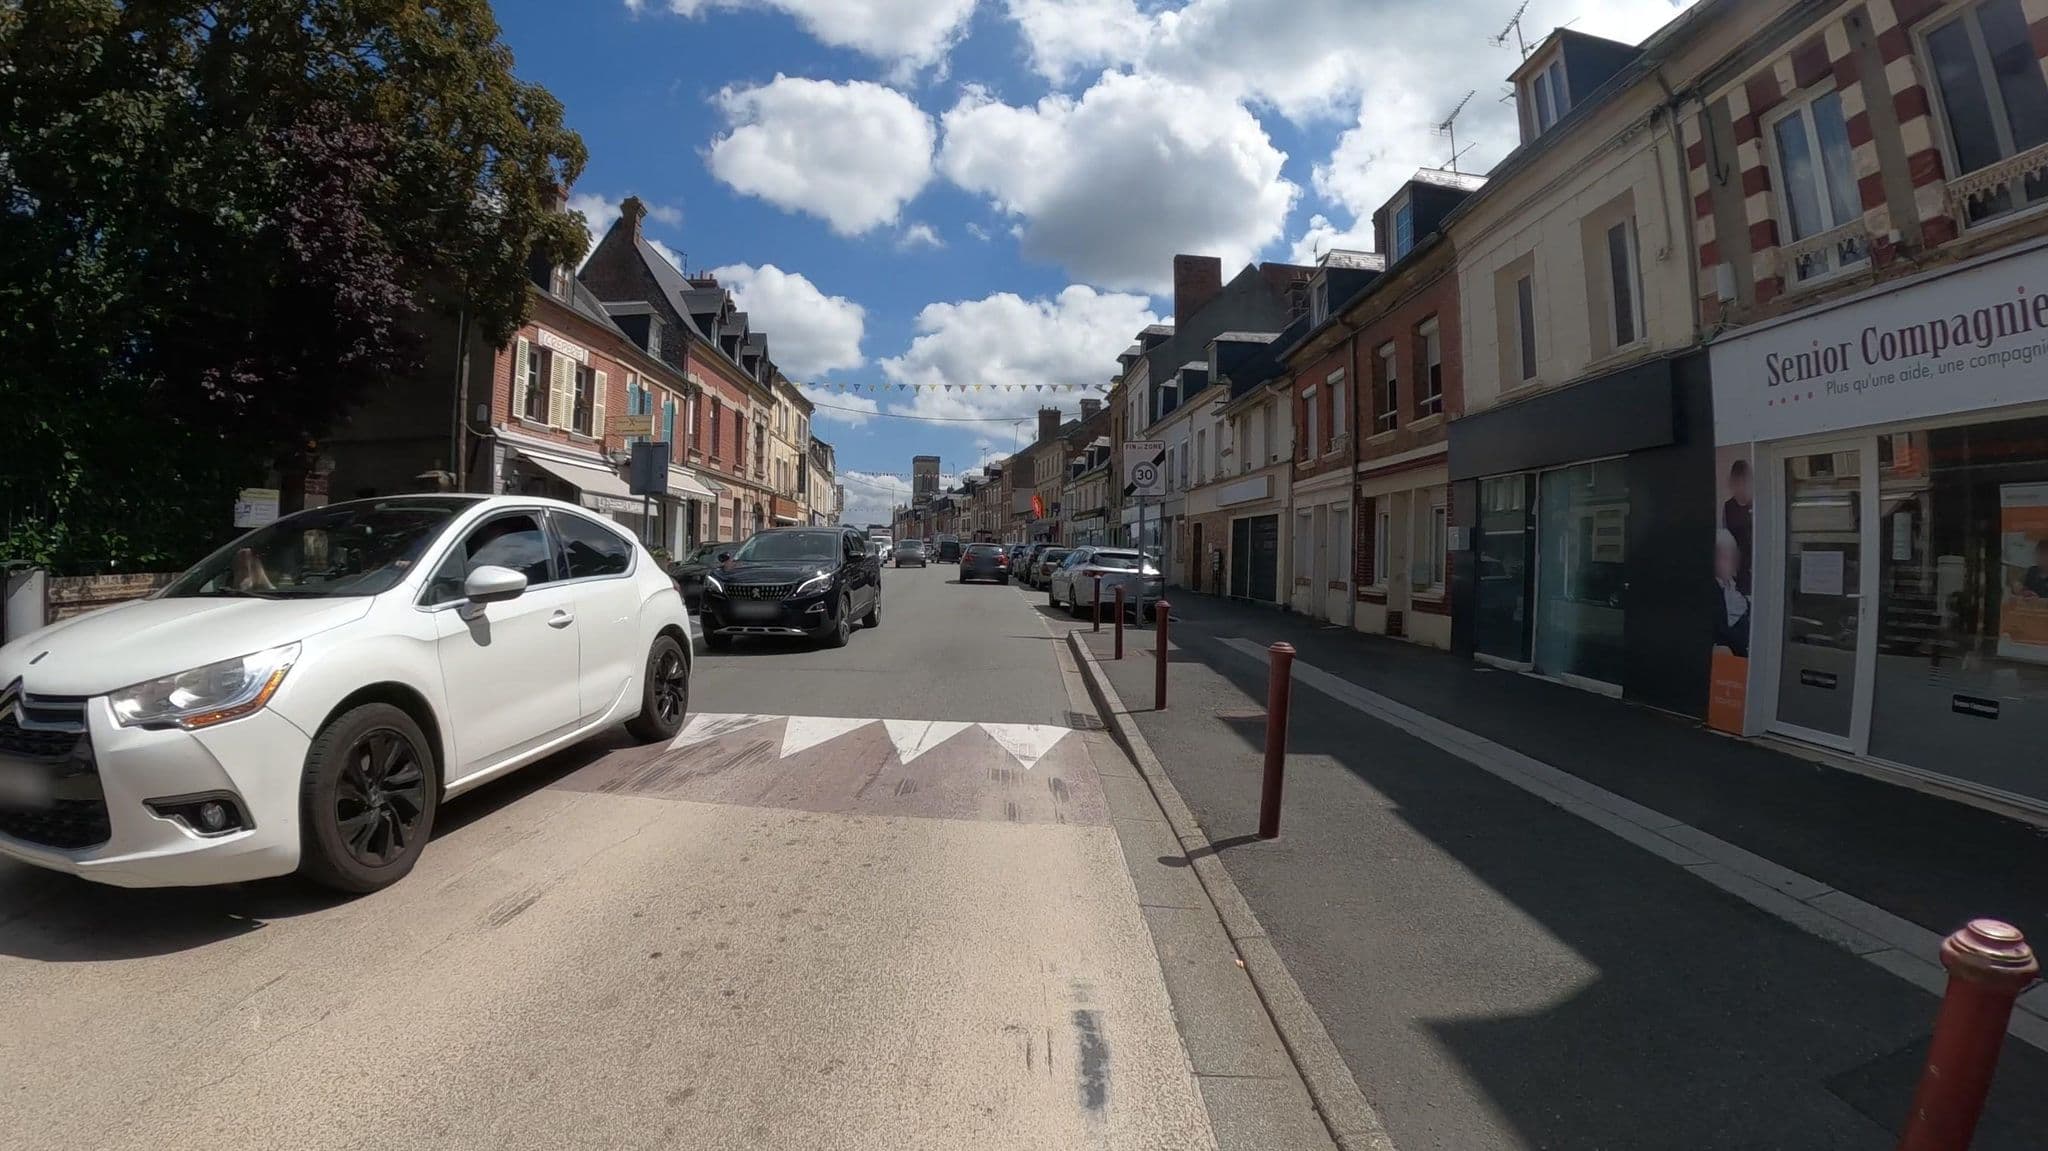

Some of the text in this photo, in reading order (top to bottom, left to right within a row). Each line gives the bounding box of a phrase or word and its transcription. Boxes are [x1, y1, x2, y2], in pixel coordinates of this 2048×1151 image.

[1766, 285, 2048, 388] Senior Compagnie
[1826, 339, 2048, 396] Plus qu'une aide, une compagni
[1137, 469, 1153, 480] 30
